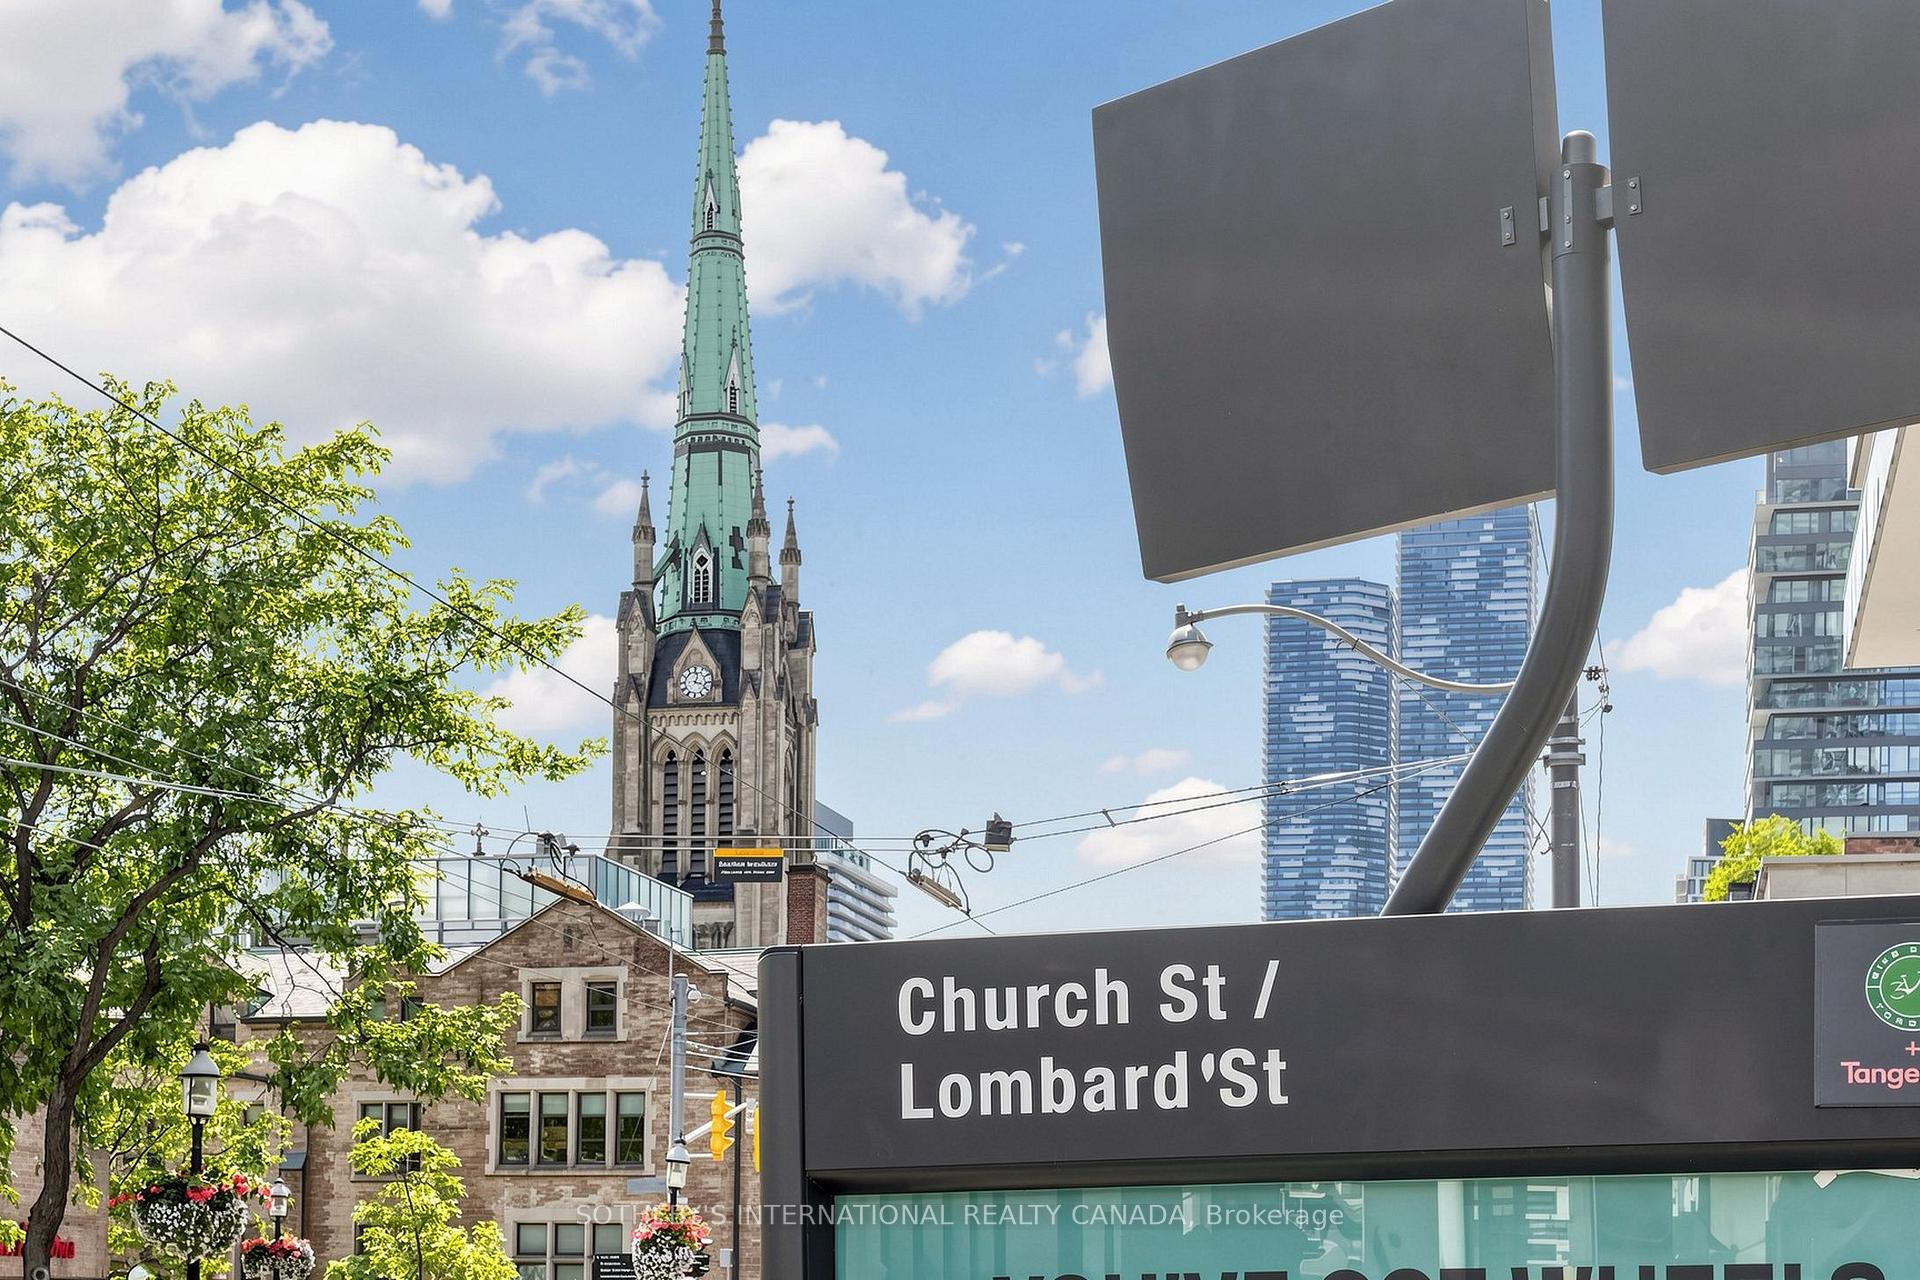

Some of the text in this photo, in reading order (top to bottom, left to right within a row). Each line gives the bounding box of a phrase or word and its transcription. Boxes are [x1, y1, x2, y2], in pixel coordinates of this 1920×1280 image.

[898, 959, 1280, 1036] Church St /
[900, 1050, 1189, 1120] Lombard
